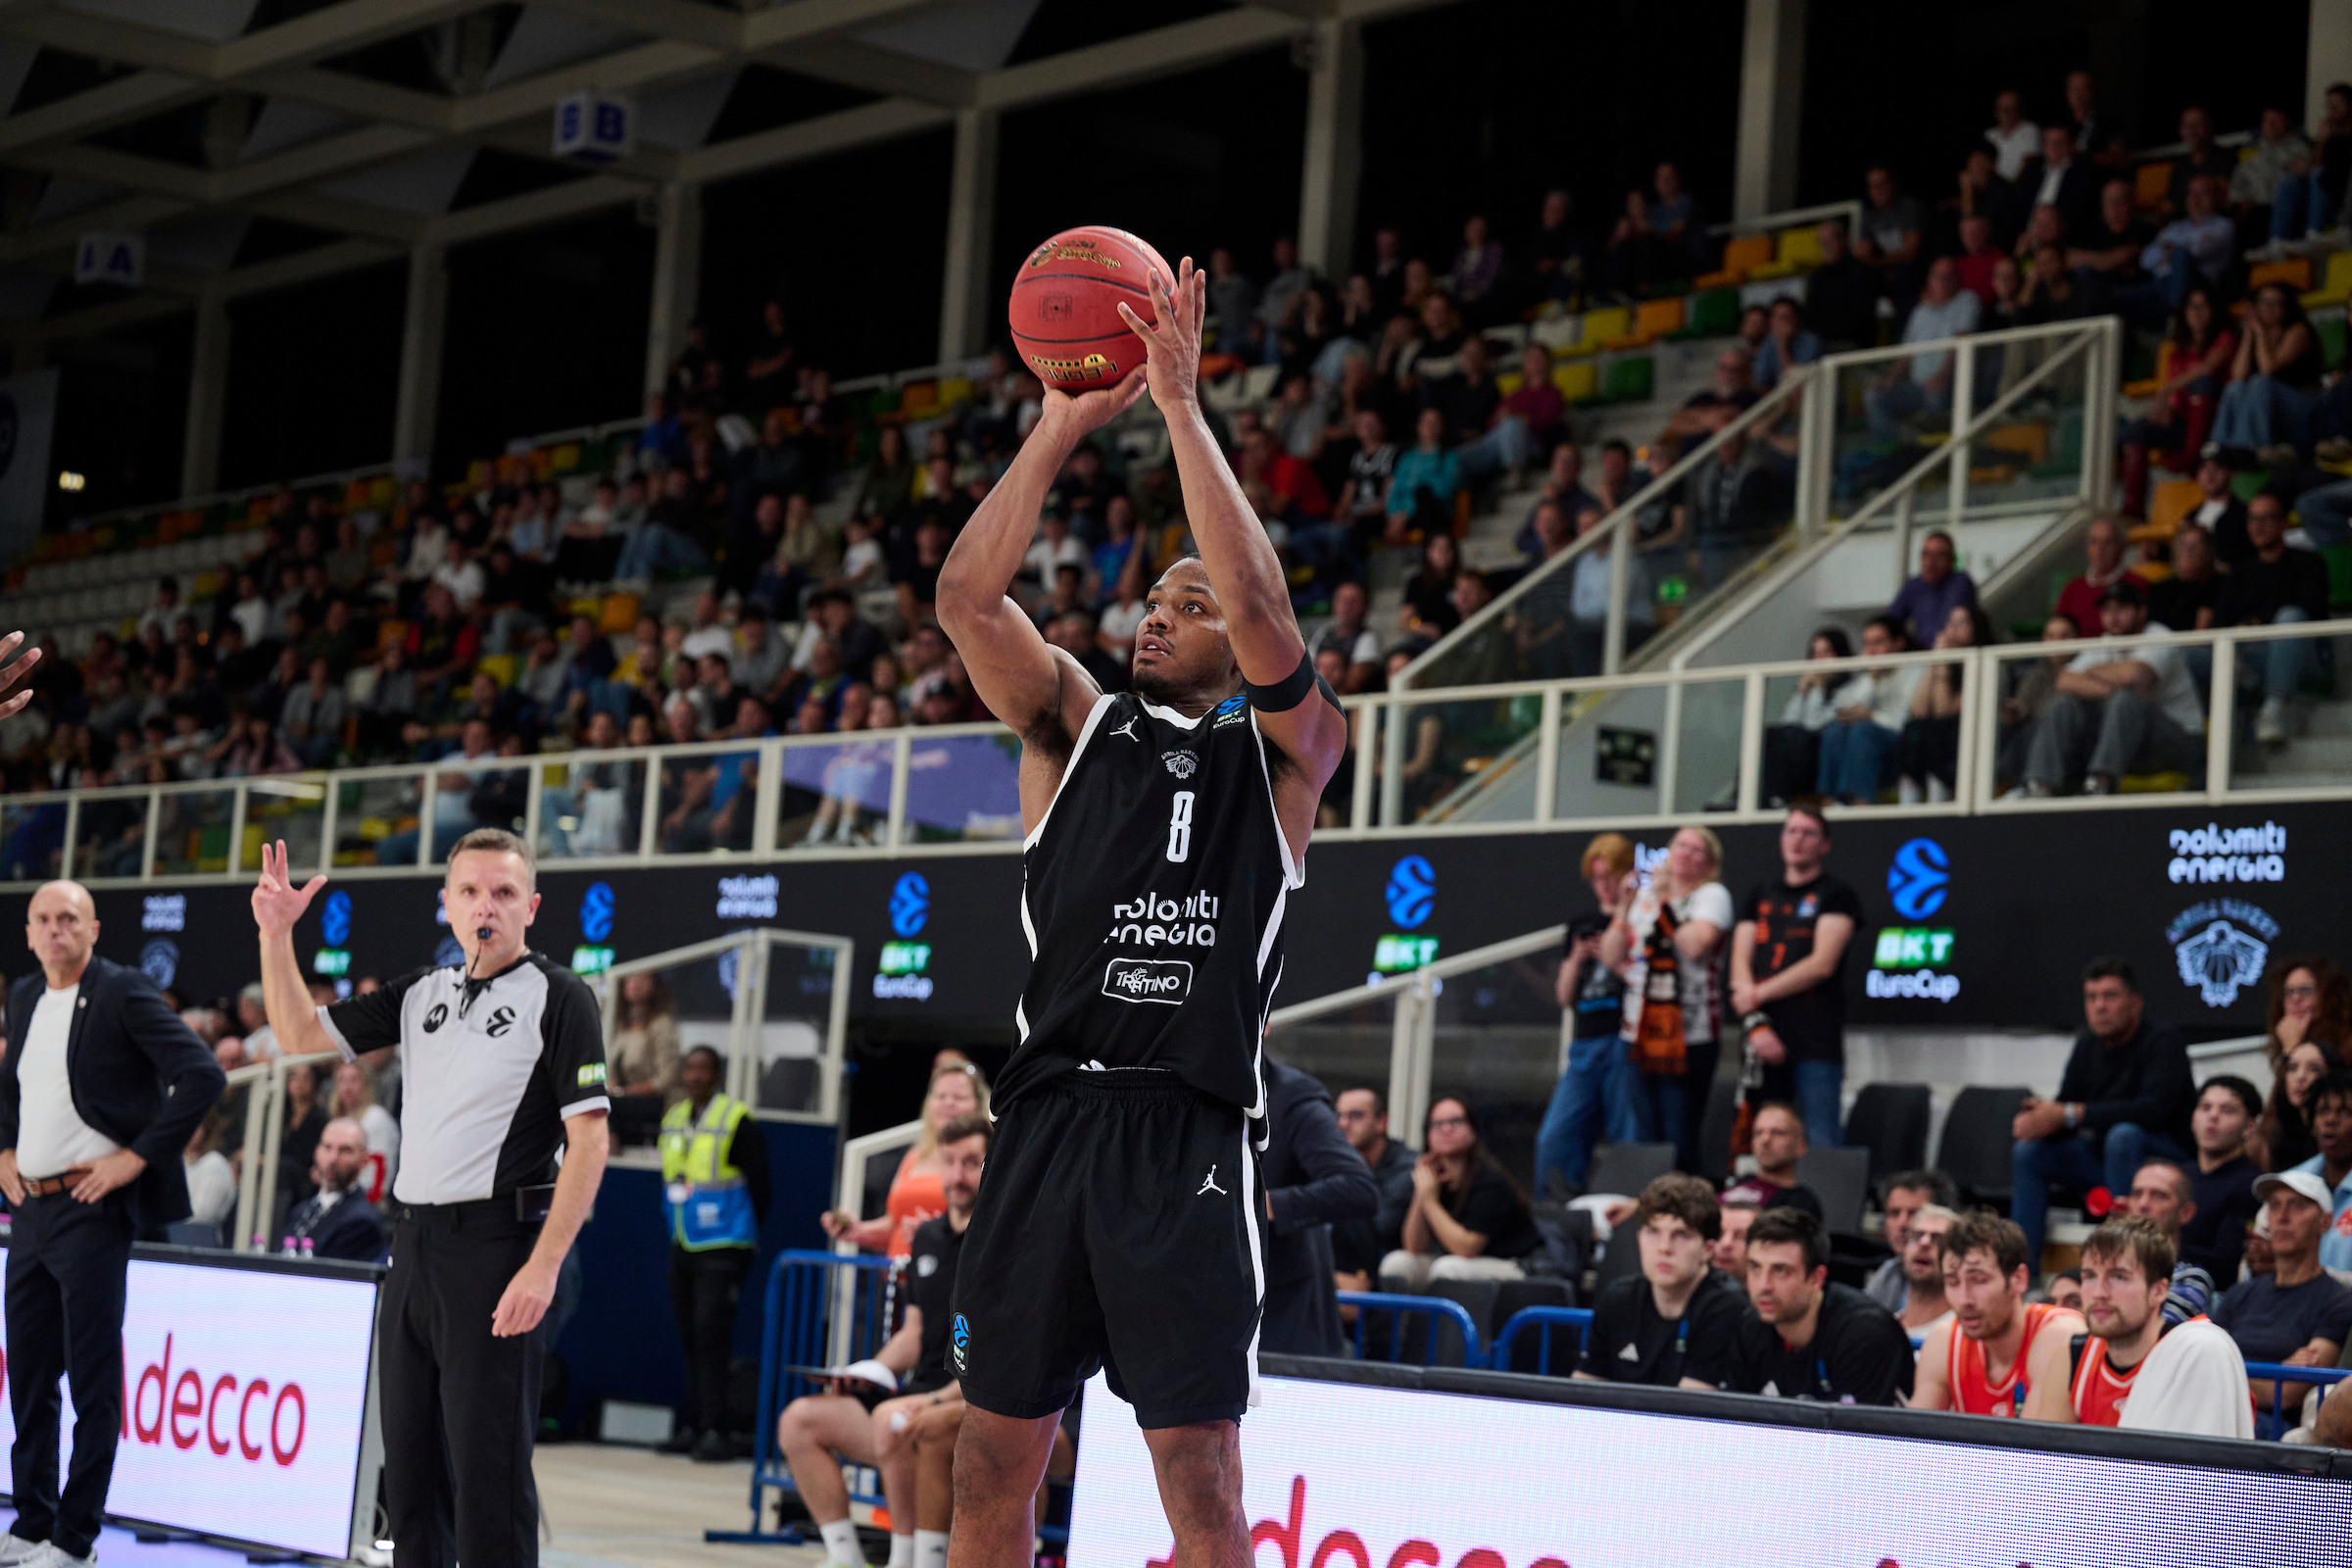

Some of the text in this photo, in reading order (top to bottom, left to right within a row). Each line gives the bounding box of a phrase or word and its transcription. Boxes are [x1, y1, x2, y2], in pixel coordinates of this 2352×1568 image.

[596, 104, 625, 142] B
[1213, 716, 1245, 729] EuroCup
[1166, 791, 1195, 863] 8
[1876, 932, 1954, 962] BKT
[1866, 968, 1960, 1004] EuroCup
[578, 1064, 607, 1085] BK
